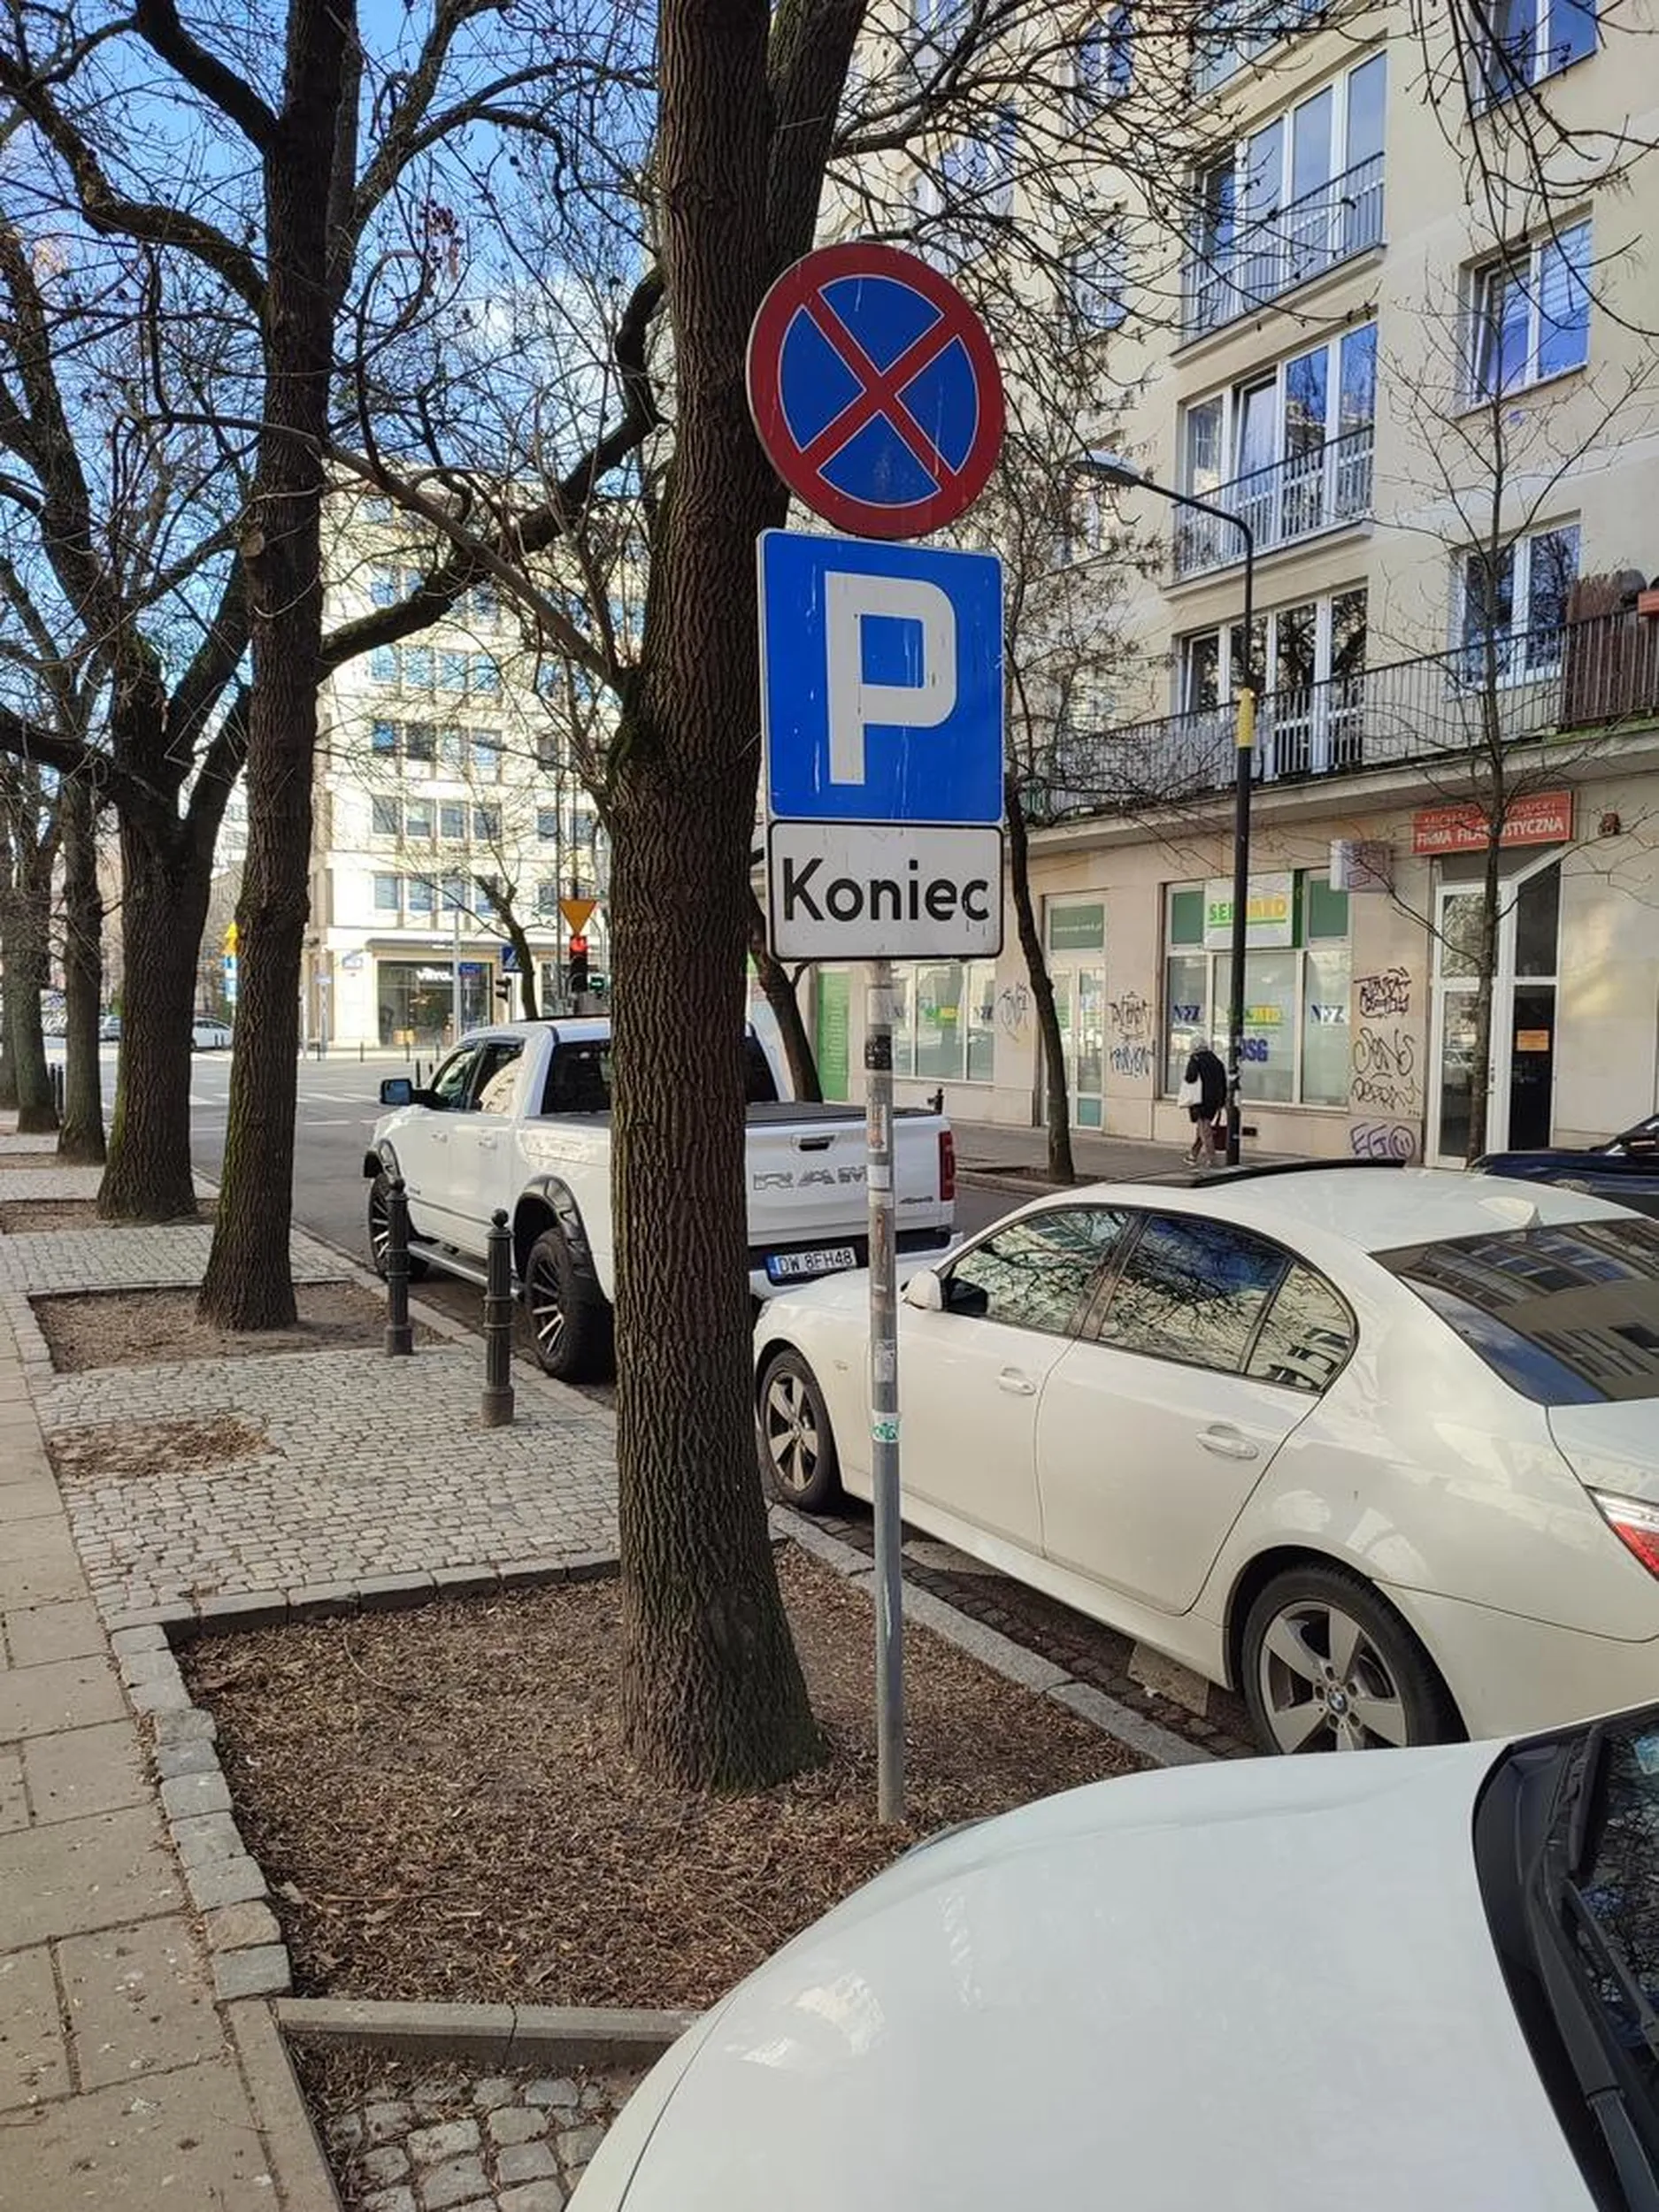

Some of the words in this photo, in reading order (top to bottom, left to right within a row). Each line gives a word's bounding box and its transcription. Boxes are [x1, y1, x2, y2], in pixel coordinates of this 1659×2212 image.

[825, 571, 957, 786] P
[783, 856, 990, 922] Koniec
[753, 1165, 868, 1191] RAM
[779, 1256, 800, 1272] DW
